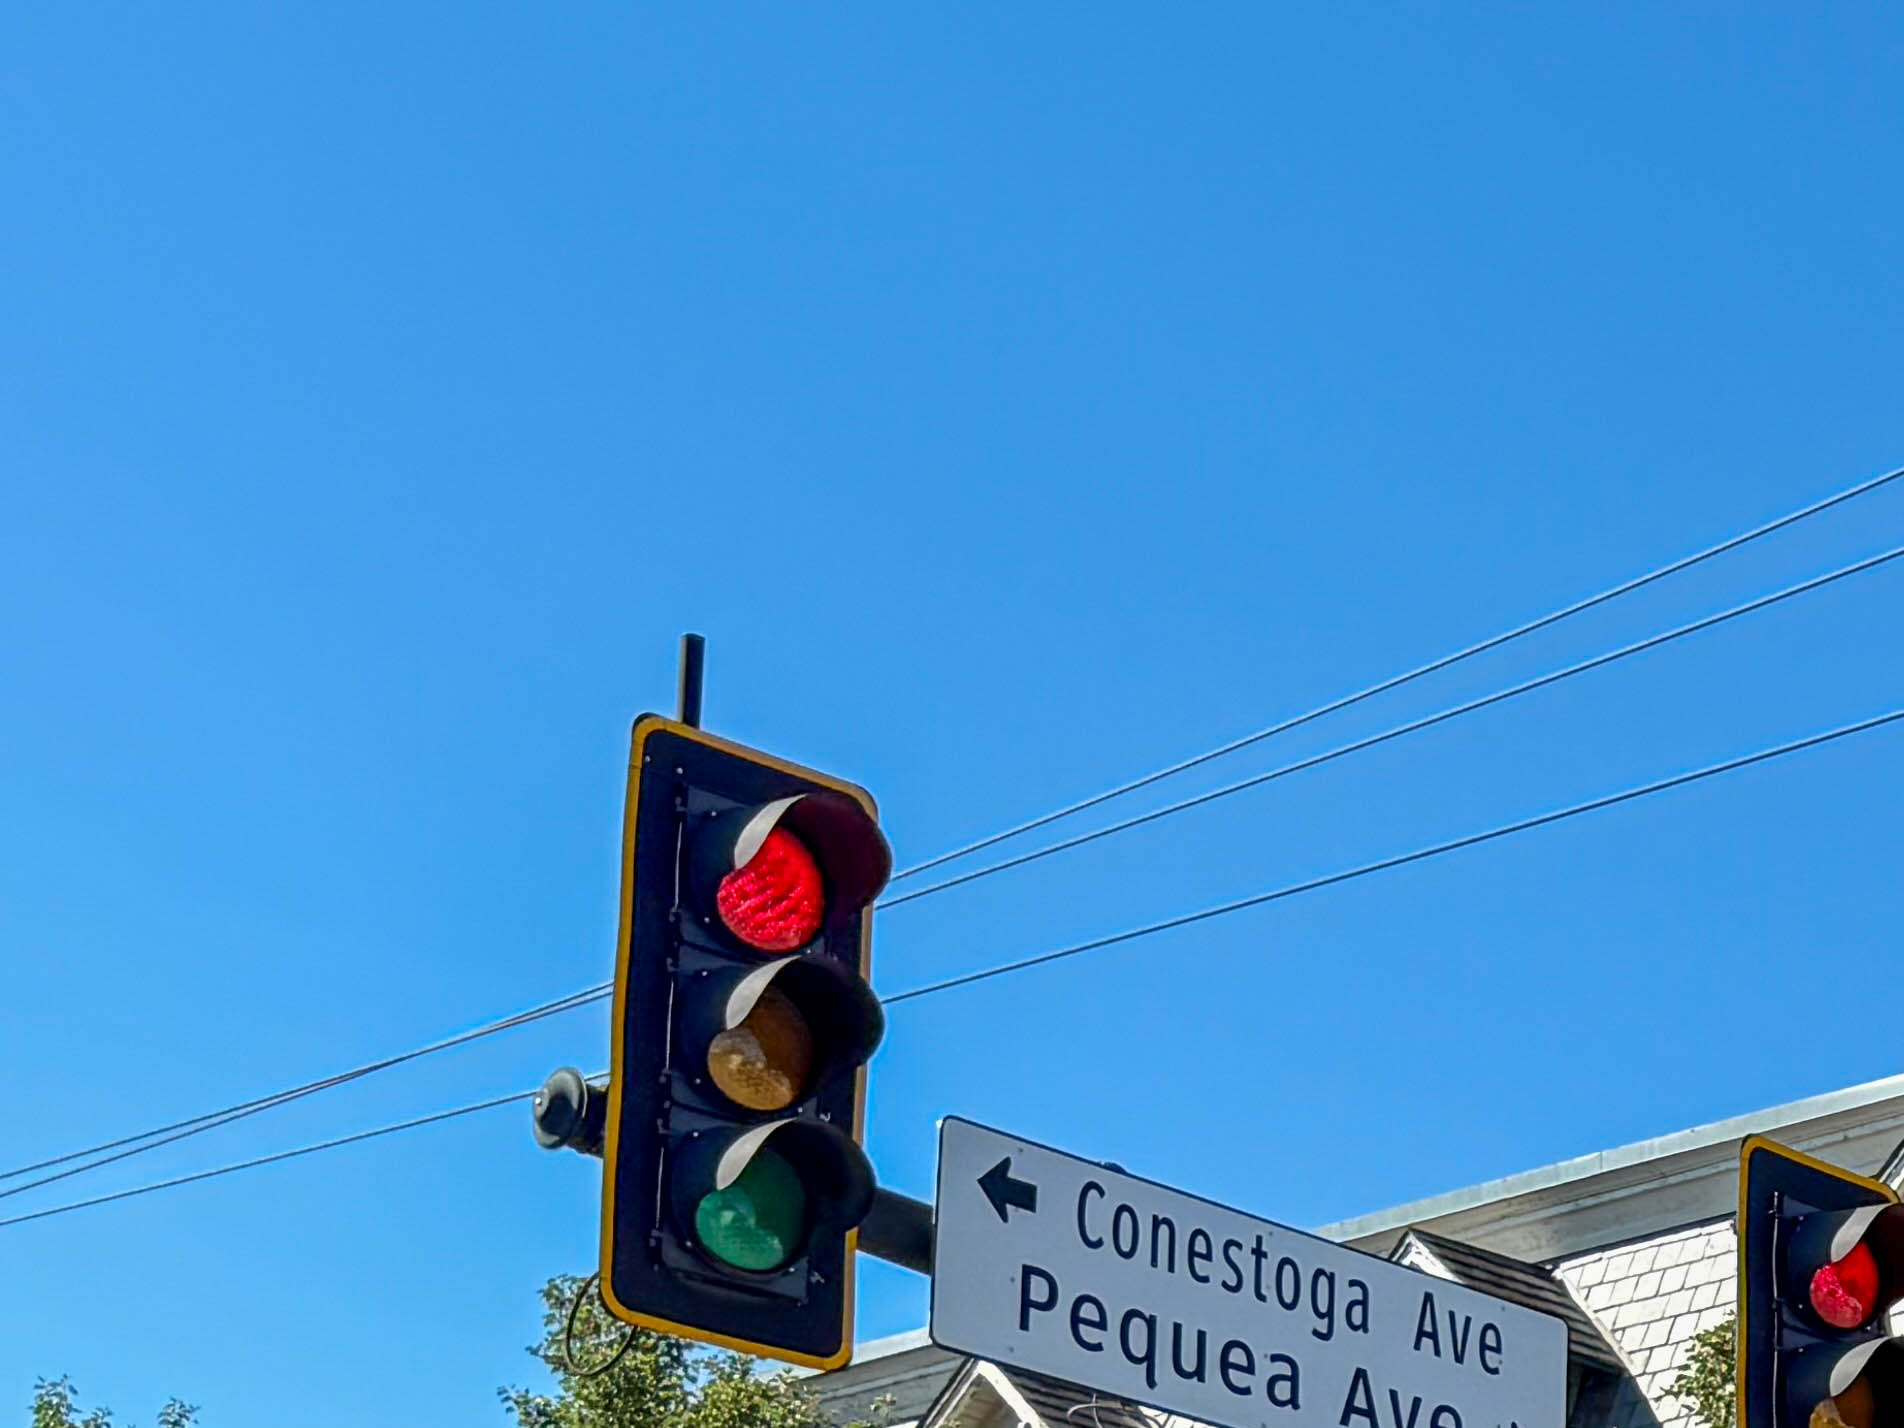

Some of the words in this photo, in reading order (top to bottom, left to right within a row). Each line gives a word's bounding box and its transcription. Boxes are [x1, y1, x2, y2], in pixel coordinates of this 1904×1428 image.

[1019, 1264, 1301, 1410] Pequea
[1077, 1181, 1370, 1341] Conestoga
[1413, 1291, 1504, 1376] Ave
